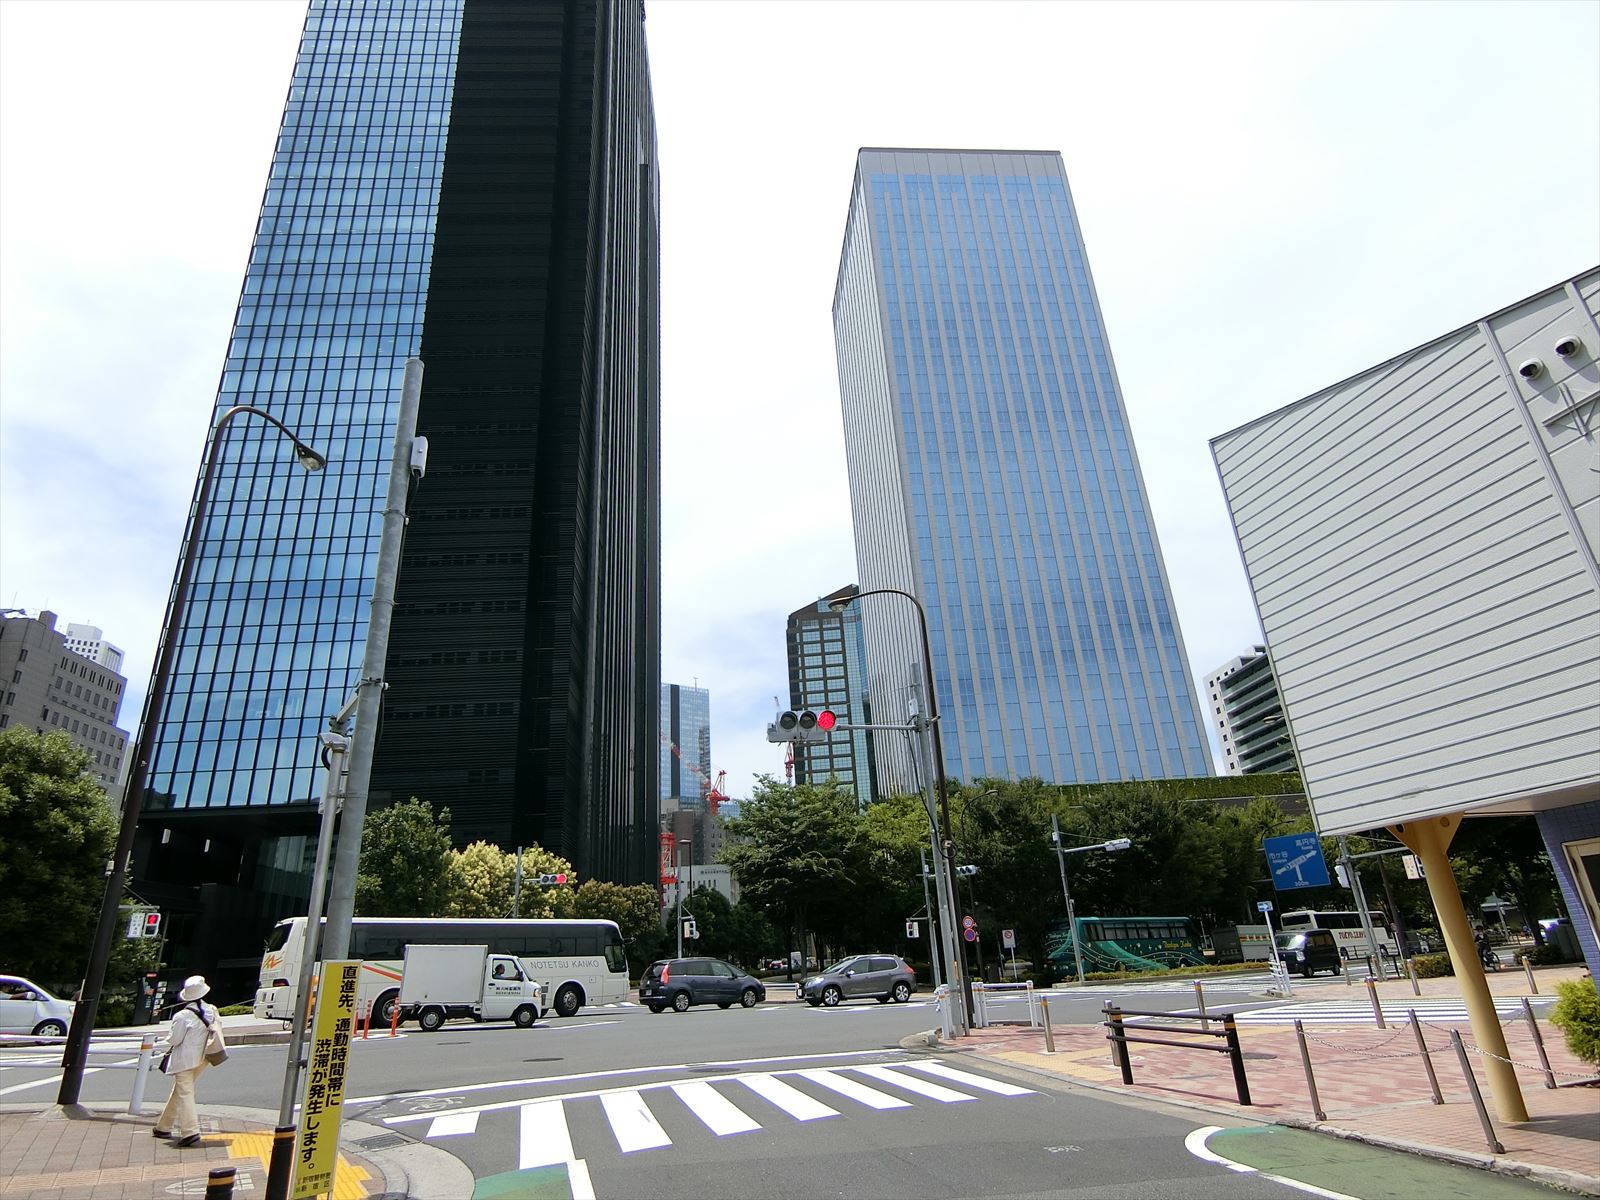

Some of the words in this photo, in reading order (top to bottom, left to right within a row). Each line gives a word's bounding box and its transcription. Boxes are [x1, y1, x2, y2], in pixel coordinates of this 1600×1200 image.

[530, 960, 569, 969] NOTETSU
[572, 959, 600, 968] KANKO
[301, 1038, 332, 1170] 渋滞が発生します。
